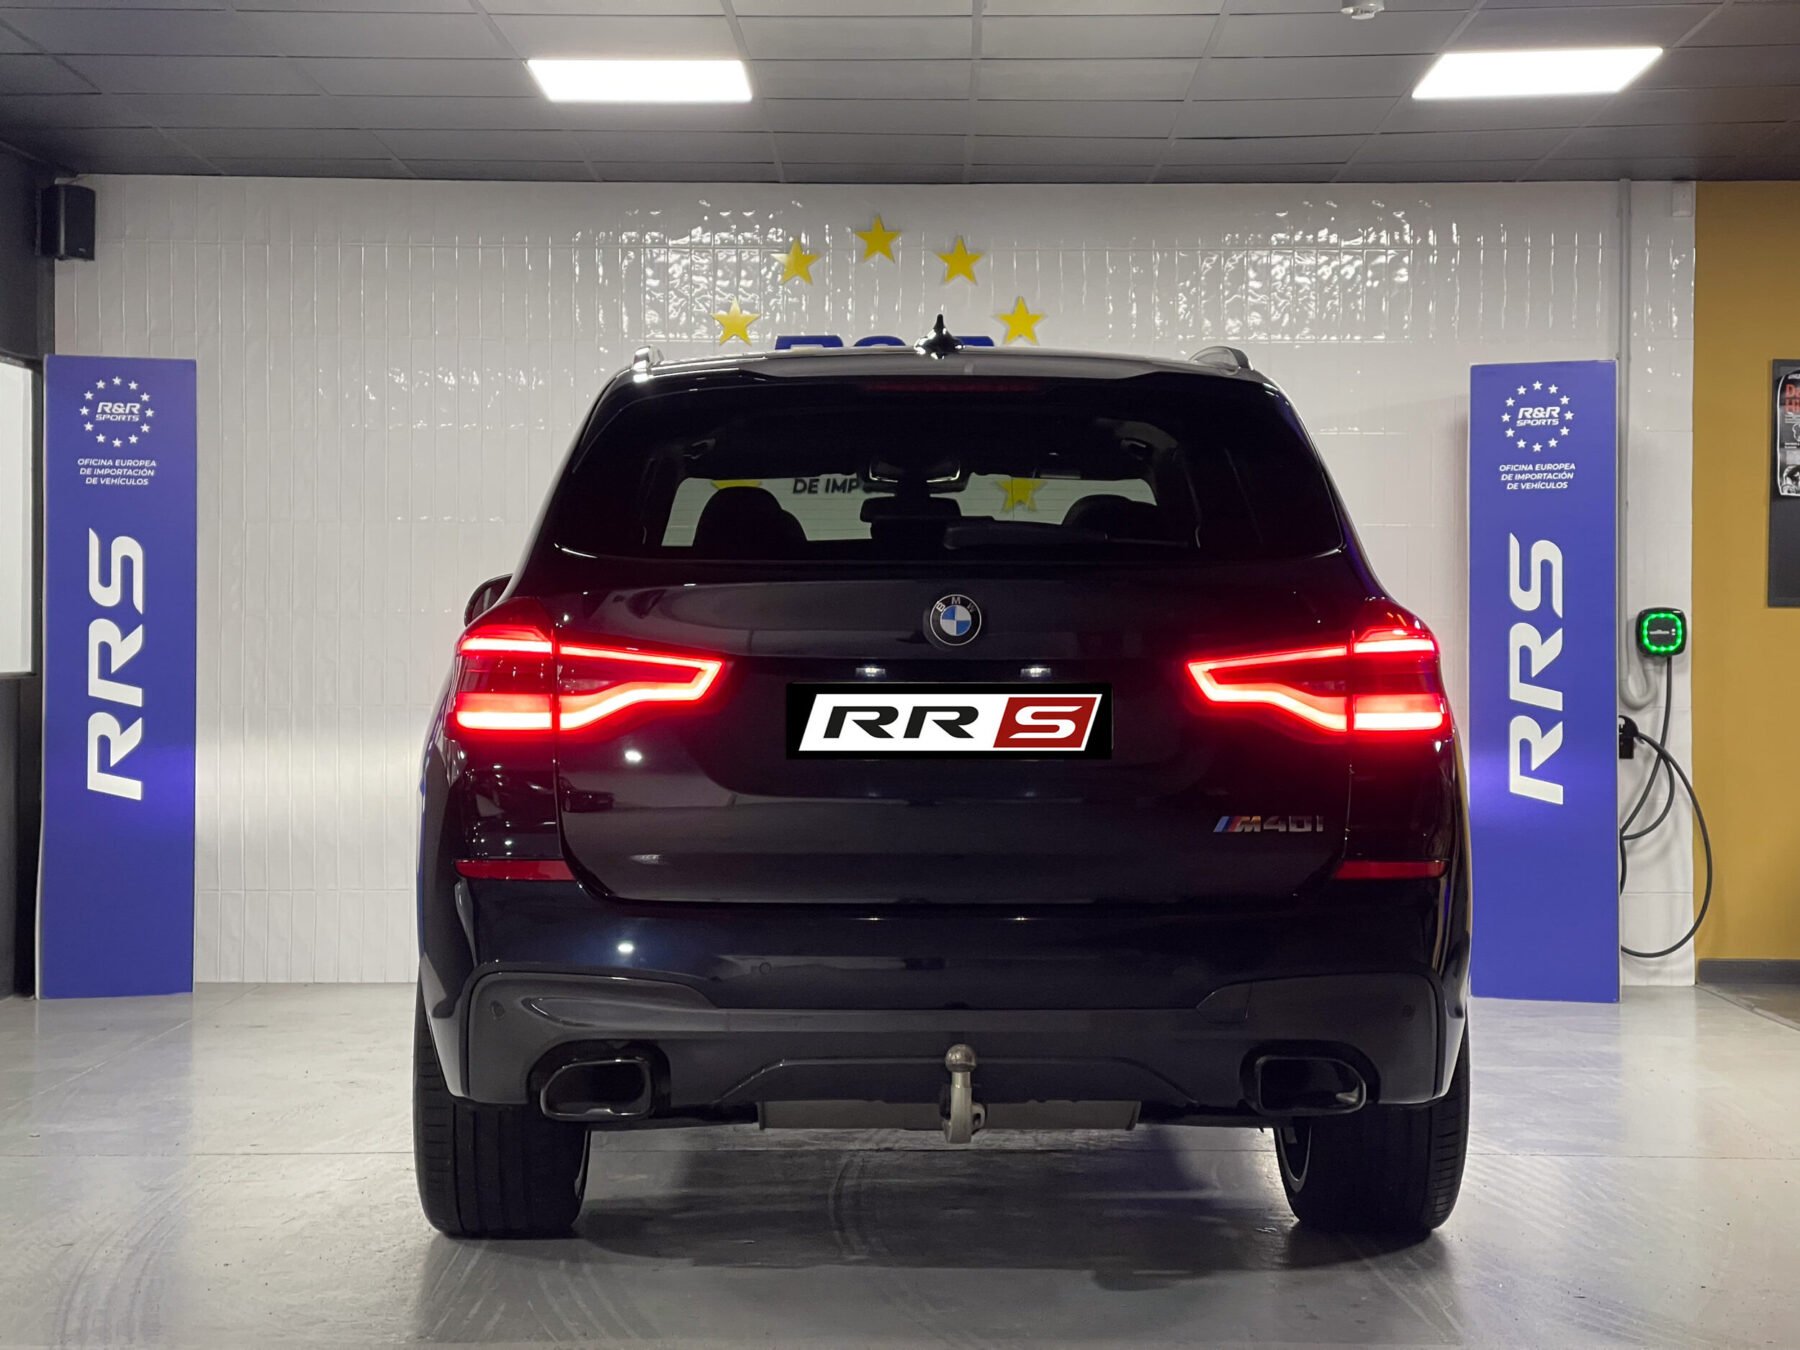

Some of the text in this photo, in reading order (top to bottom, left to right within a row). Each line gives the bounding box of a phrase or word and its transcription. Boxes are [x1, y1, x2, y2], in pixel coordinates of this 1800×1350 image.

[97, 401, 141, 414] R&R
[1518, 406, 1561, 418] R&R
[95, 414, 140, 422] SPORTS
[1516, 418, 1560, 427] SPORTS
[77, 458, 157, 467] OFICINA EUROPEA
[1535, 462, 1576, 471] EUROPEA
[80, 467, 155, 476] DE IMPORTACIÓN
[1501, 471, 1574, 481] DE IMPORTACIÓN
[85, 476, 149, 485] DE VEHÍCULOS
[1520, 481, 1568, 489] VEHÍCULOS
[793, 478, 819, 494] DE
[935, 596, 977, 613] BMW
[87, 527, 143, 800] RRS
[1509, 532, 1563, 805] RRS
